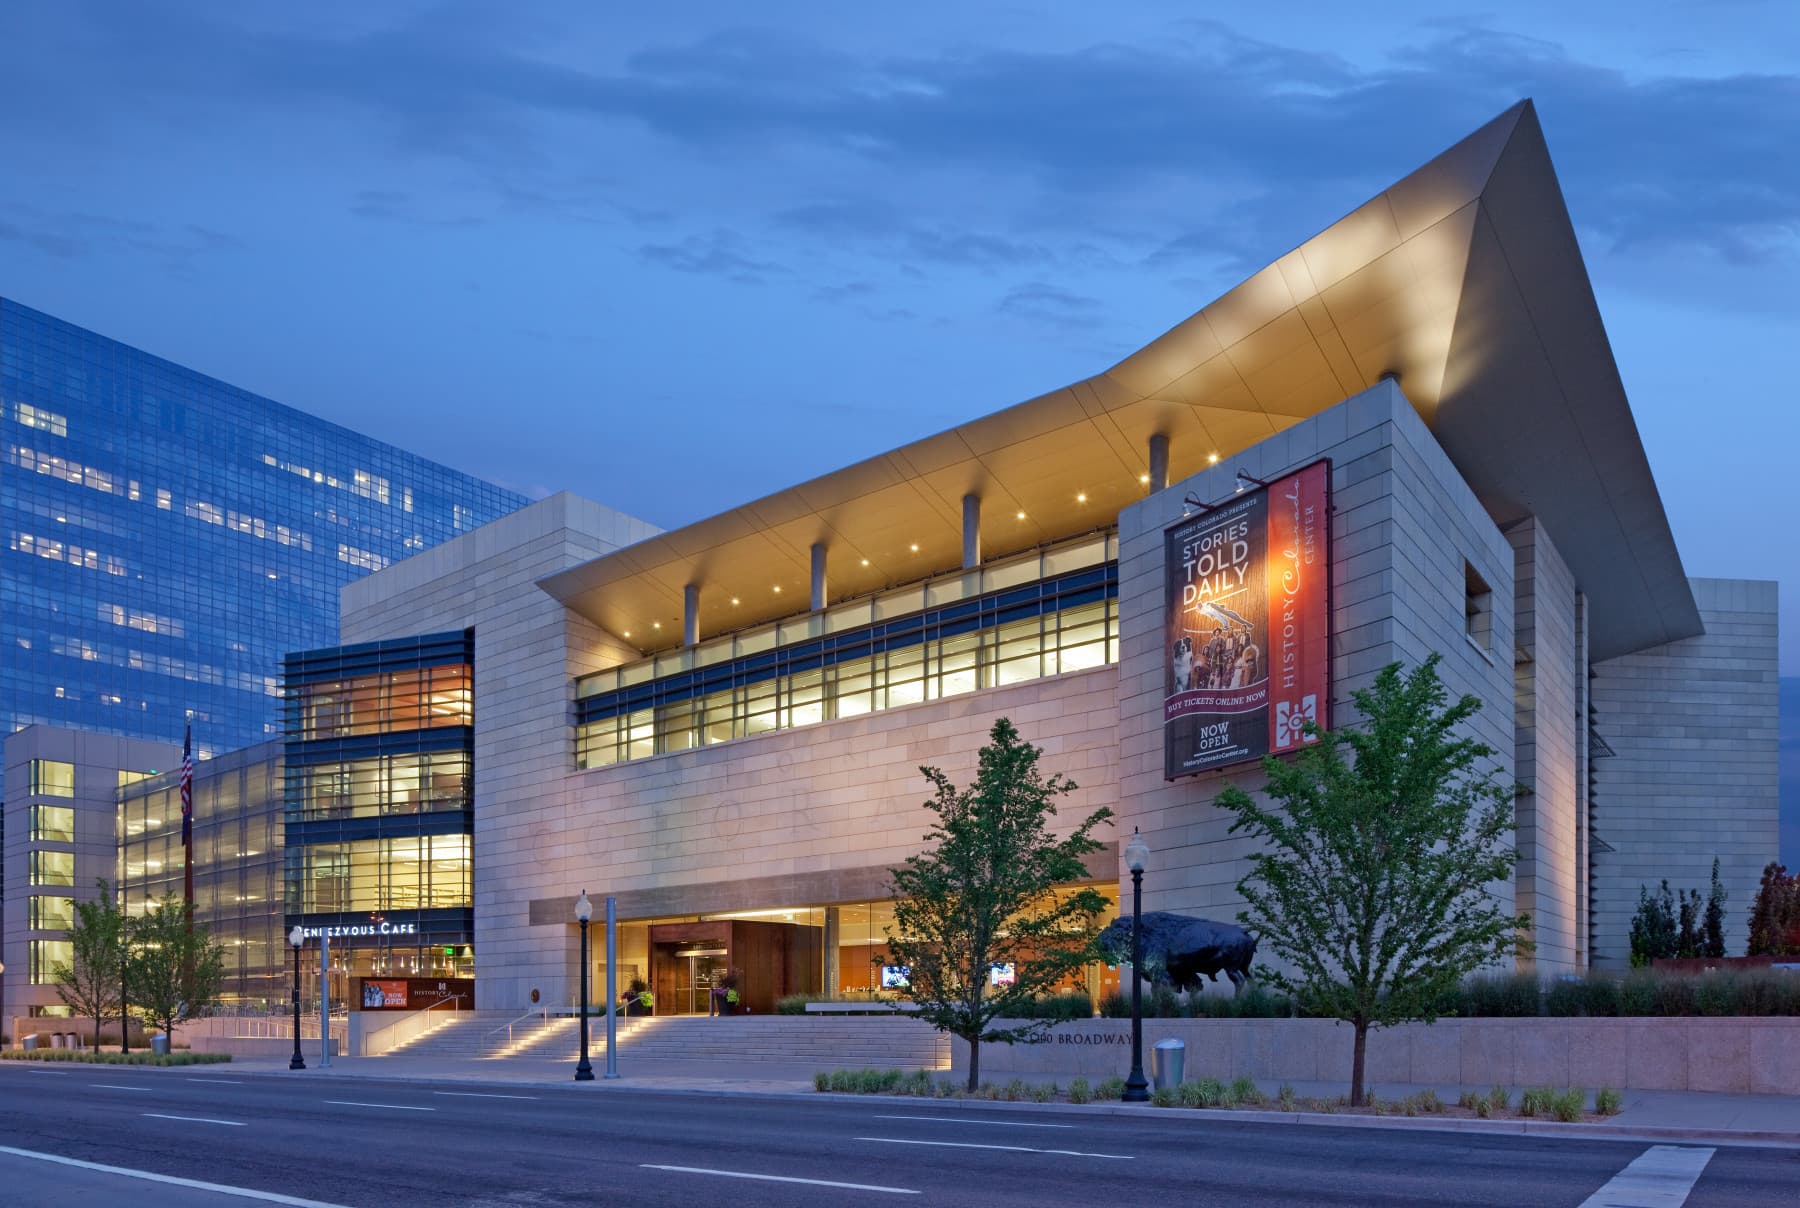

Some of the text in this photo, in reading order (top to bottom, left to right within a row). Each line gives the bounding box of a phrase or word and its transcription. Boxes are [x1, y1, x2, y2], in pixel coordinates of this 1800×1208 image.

[1174, 498, 1257, 540] HISTORY COLORADO PRESENTS
[1304, 505, 1315, 565] CENTER
[1183, 521, 1248, 560] STORIES
[1183, 540, 1248, 582] TOLD
[1183, 562, 1249, 606] DAILY
[1281, 478, 1301, 688] HISTORY Colorado
[1167, 689, 1267, 713] BUY TICKETS ONLINE NOW
[1199, 734, 1229, 750] OPEN
[1200, 721, 1230, 739] NOW
[1058, 1033, 1133, 1045] BROADWAY
